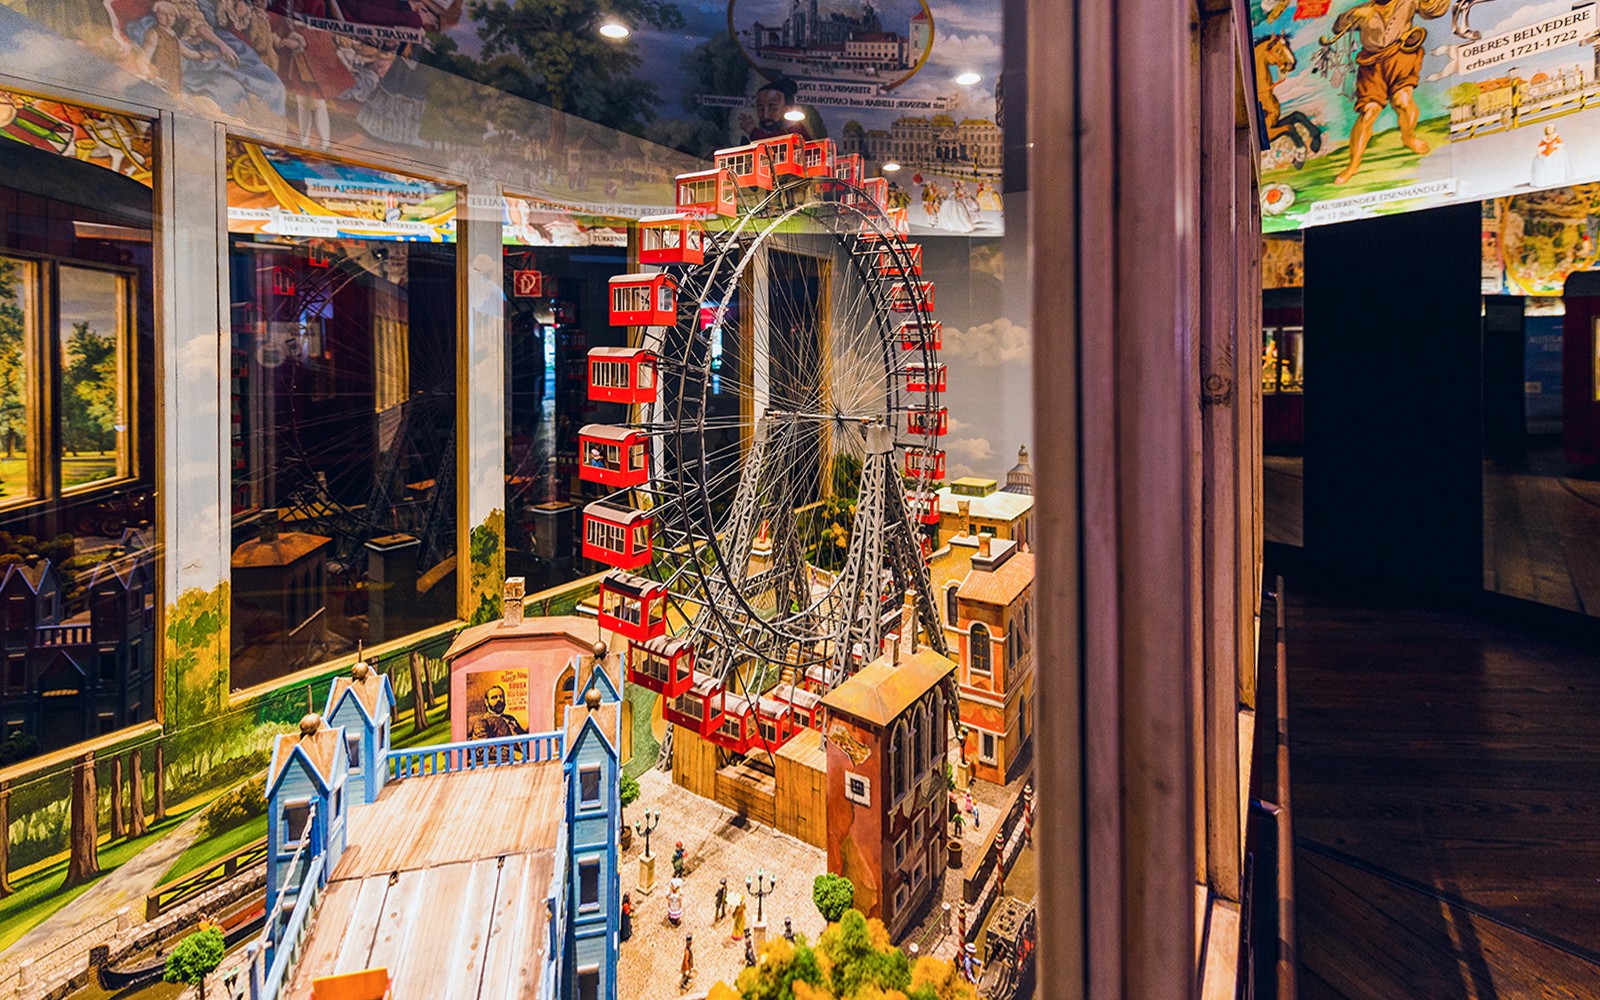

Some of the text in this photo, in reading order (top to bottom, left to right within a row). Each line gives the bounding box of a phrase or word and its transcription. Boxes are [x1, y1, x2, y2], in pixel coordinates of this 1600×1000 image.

[1462, 9, 1591, 58] OBERES BELVEDERE
[1465, 29, 1579, 71] erbaut 1721-1722
[283, 215, 318, 225] HERZOG
[335, 219, 365, 228] BAYERN
